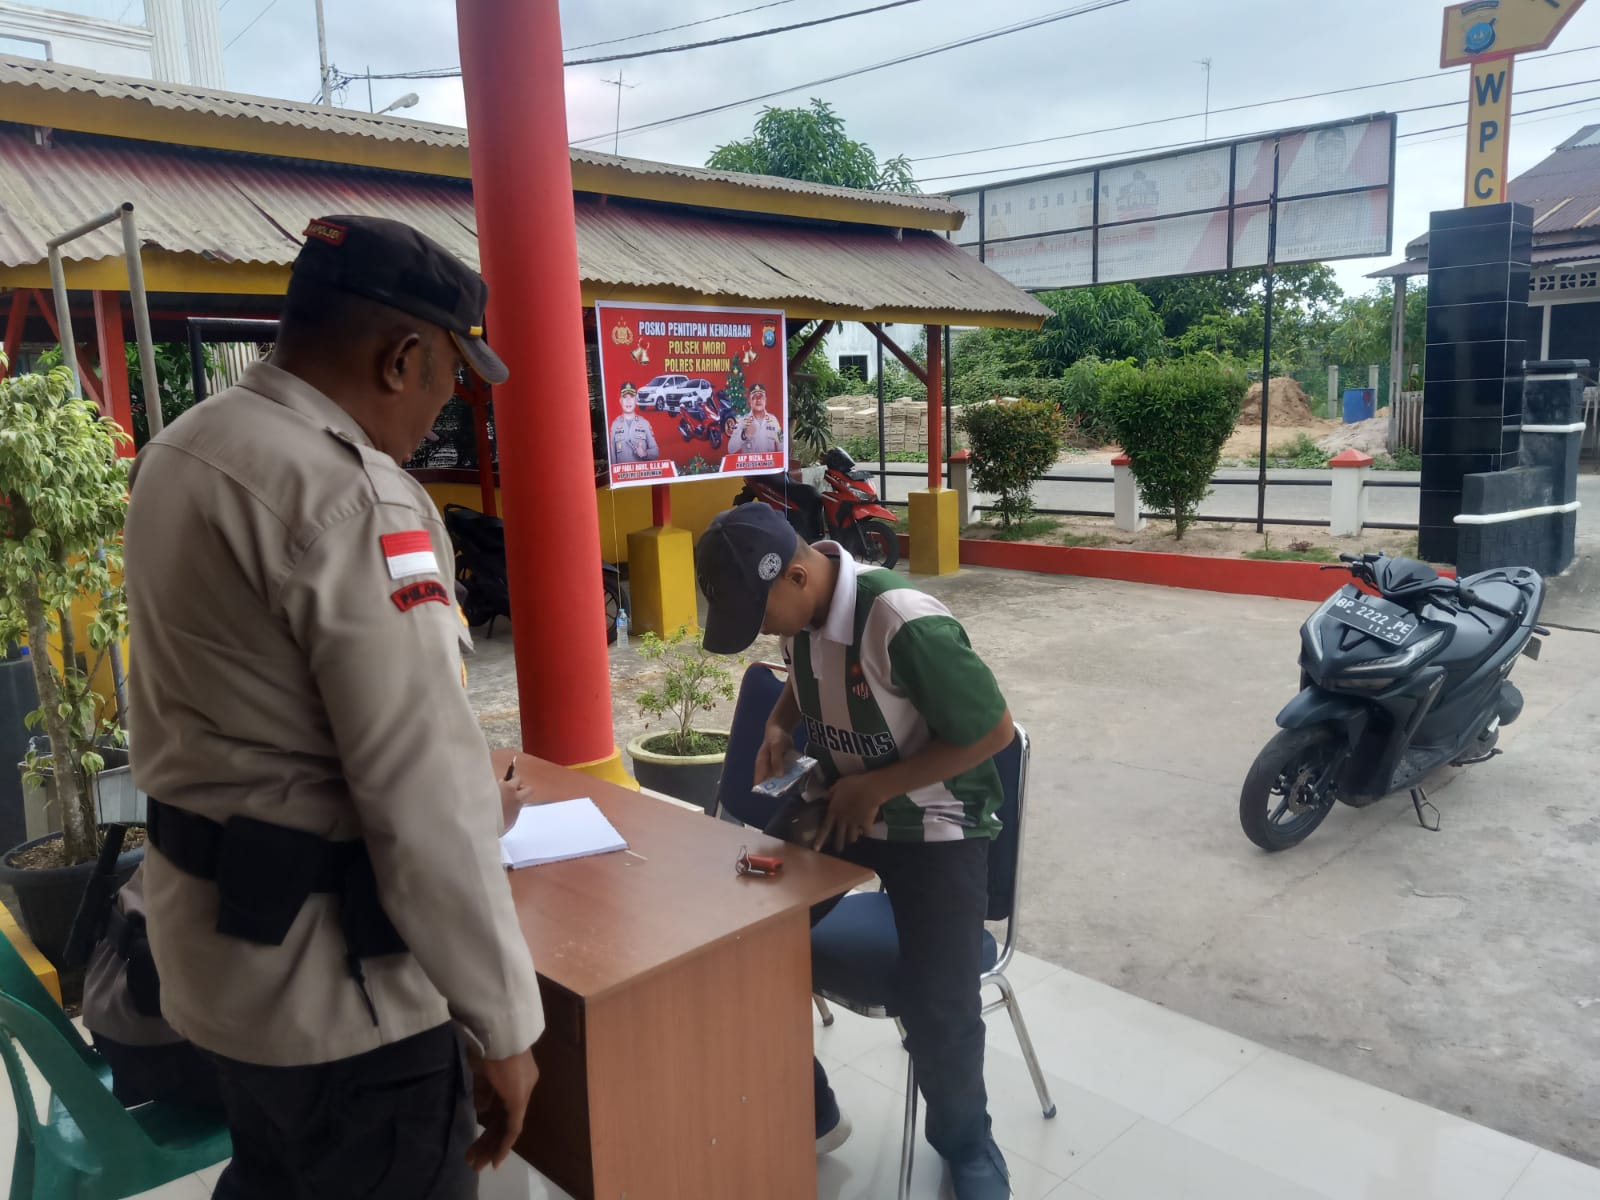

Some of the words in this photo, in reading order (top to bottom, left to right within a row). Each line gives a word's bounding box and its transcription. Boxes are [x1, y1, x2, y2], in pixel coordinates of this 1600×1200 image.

[638, 321, 666, 336] POSKO
[668, 322, 707, 337] PENITIPAN
[709, 323, 752, 338] KENDARAAN
[668, 340, 700, 355] POLSEK
[702, 341, 726, 355] MORO
[664, 358, 694, 372] POLRES
[695, 358, 731, 372] KARIMUN
[1335, 597, 1355, 609] BP
[1356, 606, 1389, 625] 2222
[1392, 621, 1413, 634] PE
